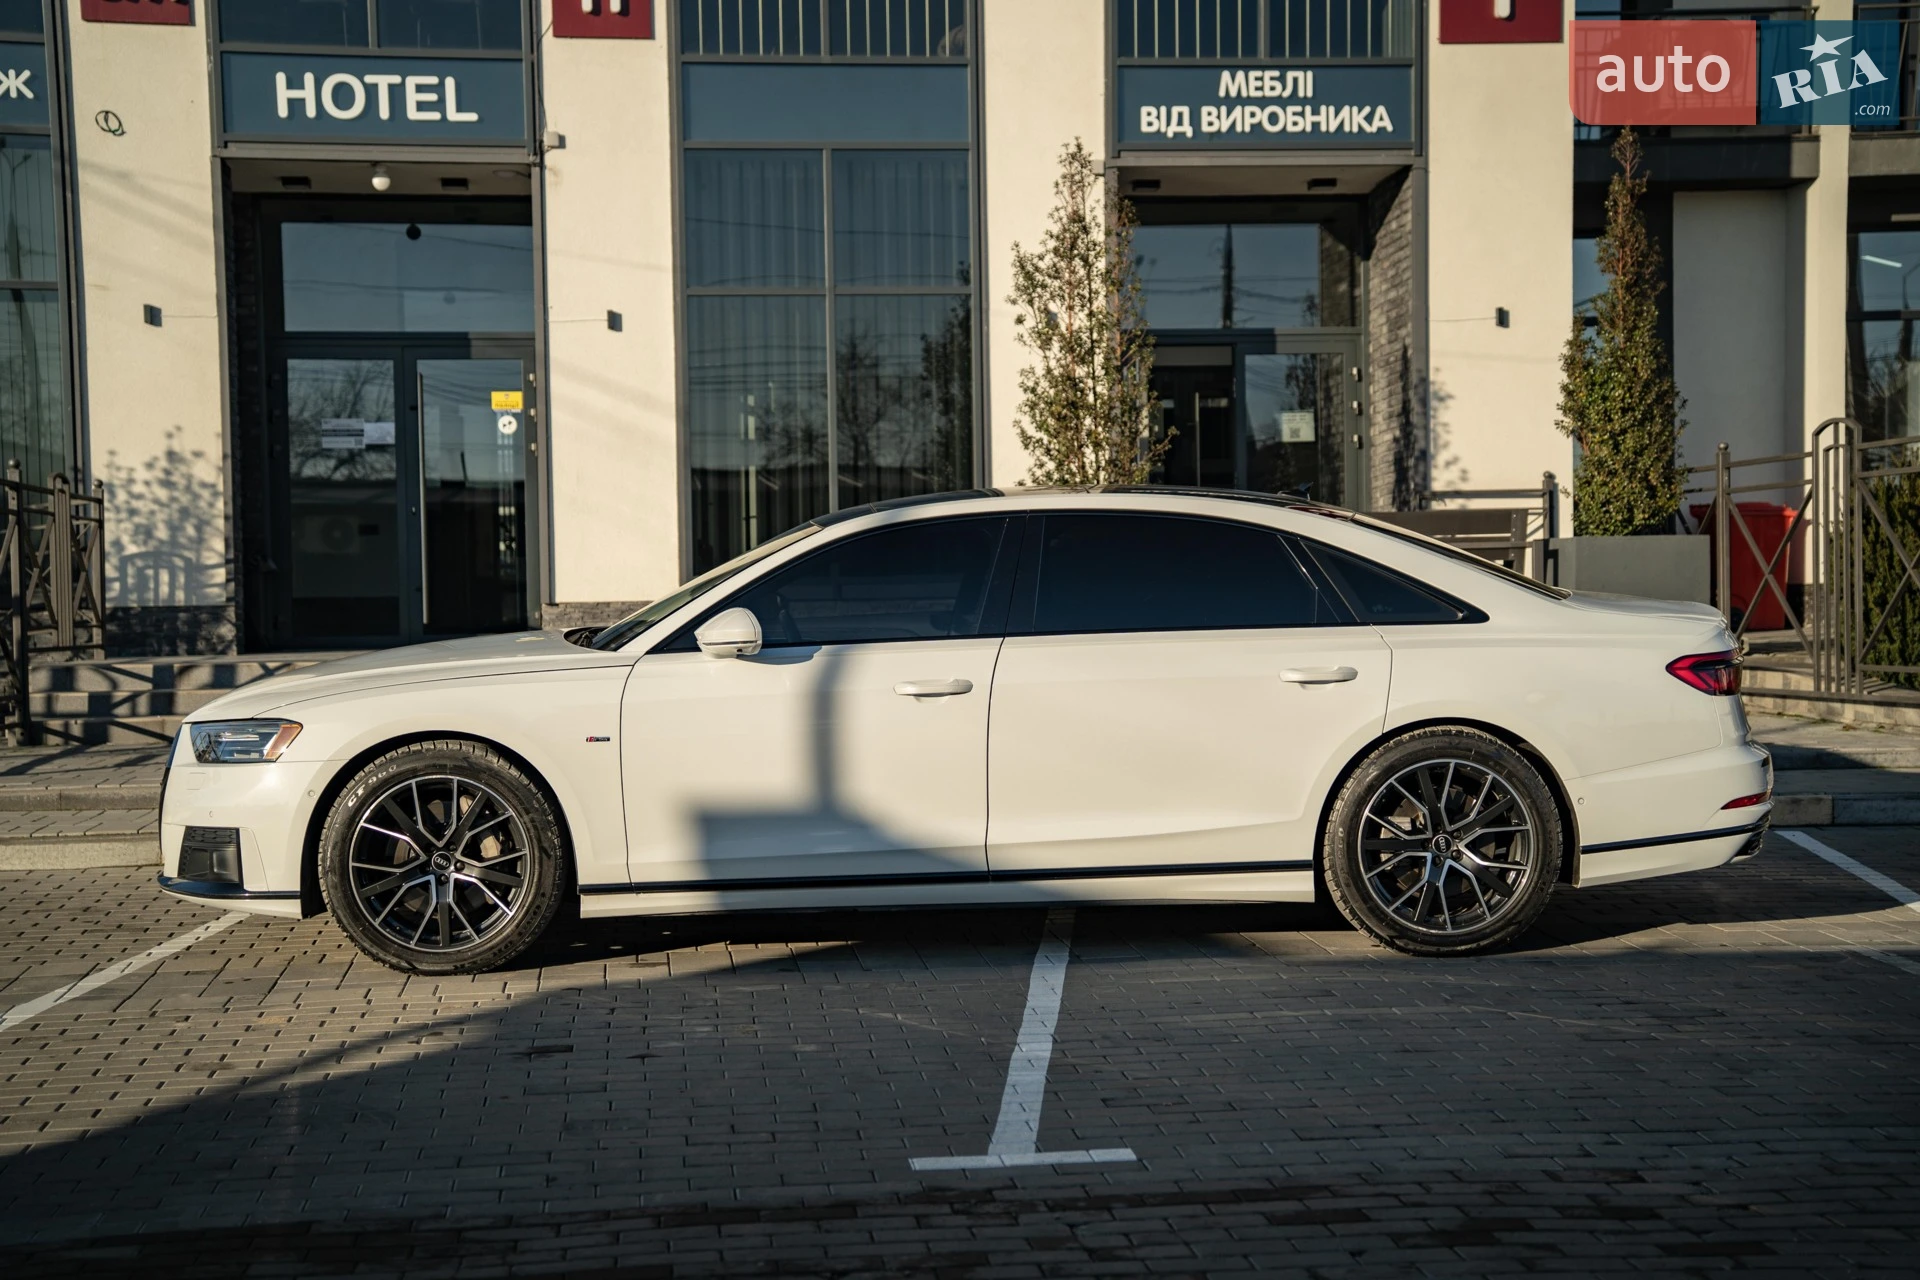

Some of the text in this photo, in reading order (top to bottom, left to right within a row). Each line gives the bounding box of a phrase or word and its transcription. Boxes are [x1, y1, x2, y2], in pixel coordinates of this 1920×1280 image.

[275, 71, 479, 122] HOTEL
[1218, 70, 1313, 98] МЕБЛІ
[1140, 104, 1394, 138] ВІД ВИРОБНИКА
